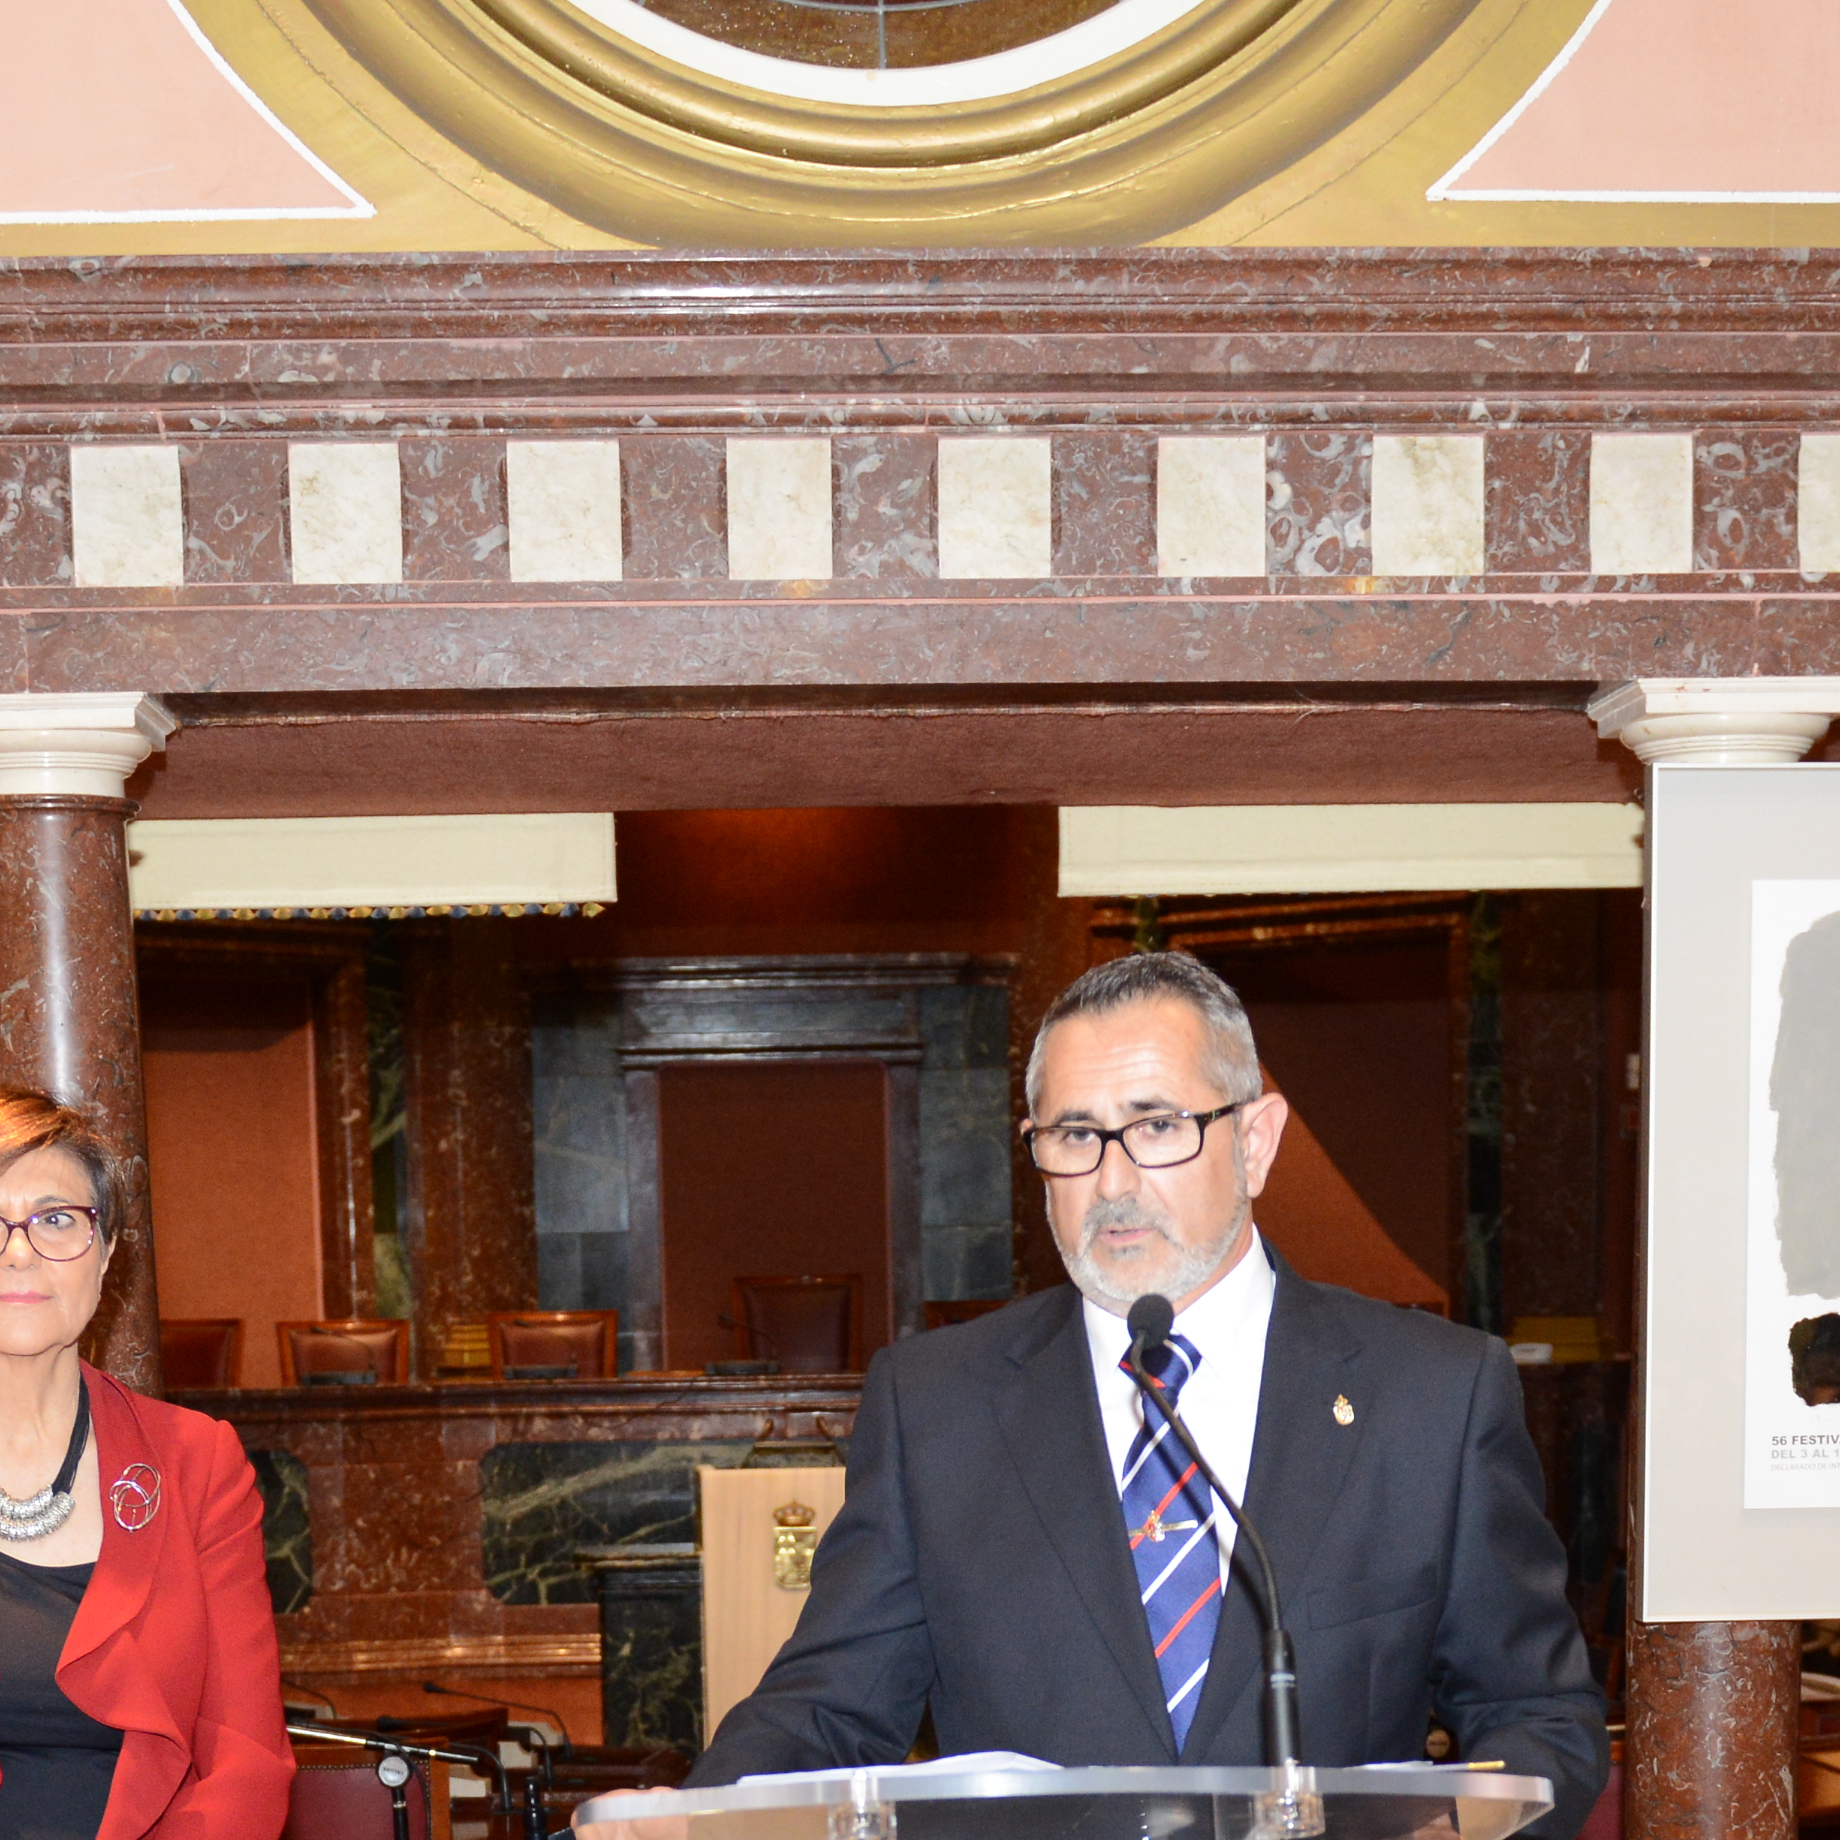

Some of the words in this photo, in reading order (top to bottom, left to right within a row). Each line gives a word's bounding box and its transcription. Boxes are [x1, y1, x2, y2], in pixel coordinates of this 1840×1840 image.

[1772, 1435, 1787, 1446] 56
[1771, 1449, 1796, 1460] DEL
[1800, 1448, 1808, 1459] 3
[1812, 1448, 1830, 1459] AL
[1770, 1462, 1815, 1471] DECLARADO
[1817, 1462, 1827, 1471] DE
